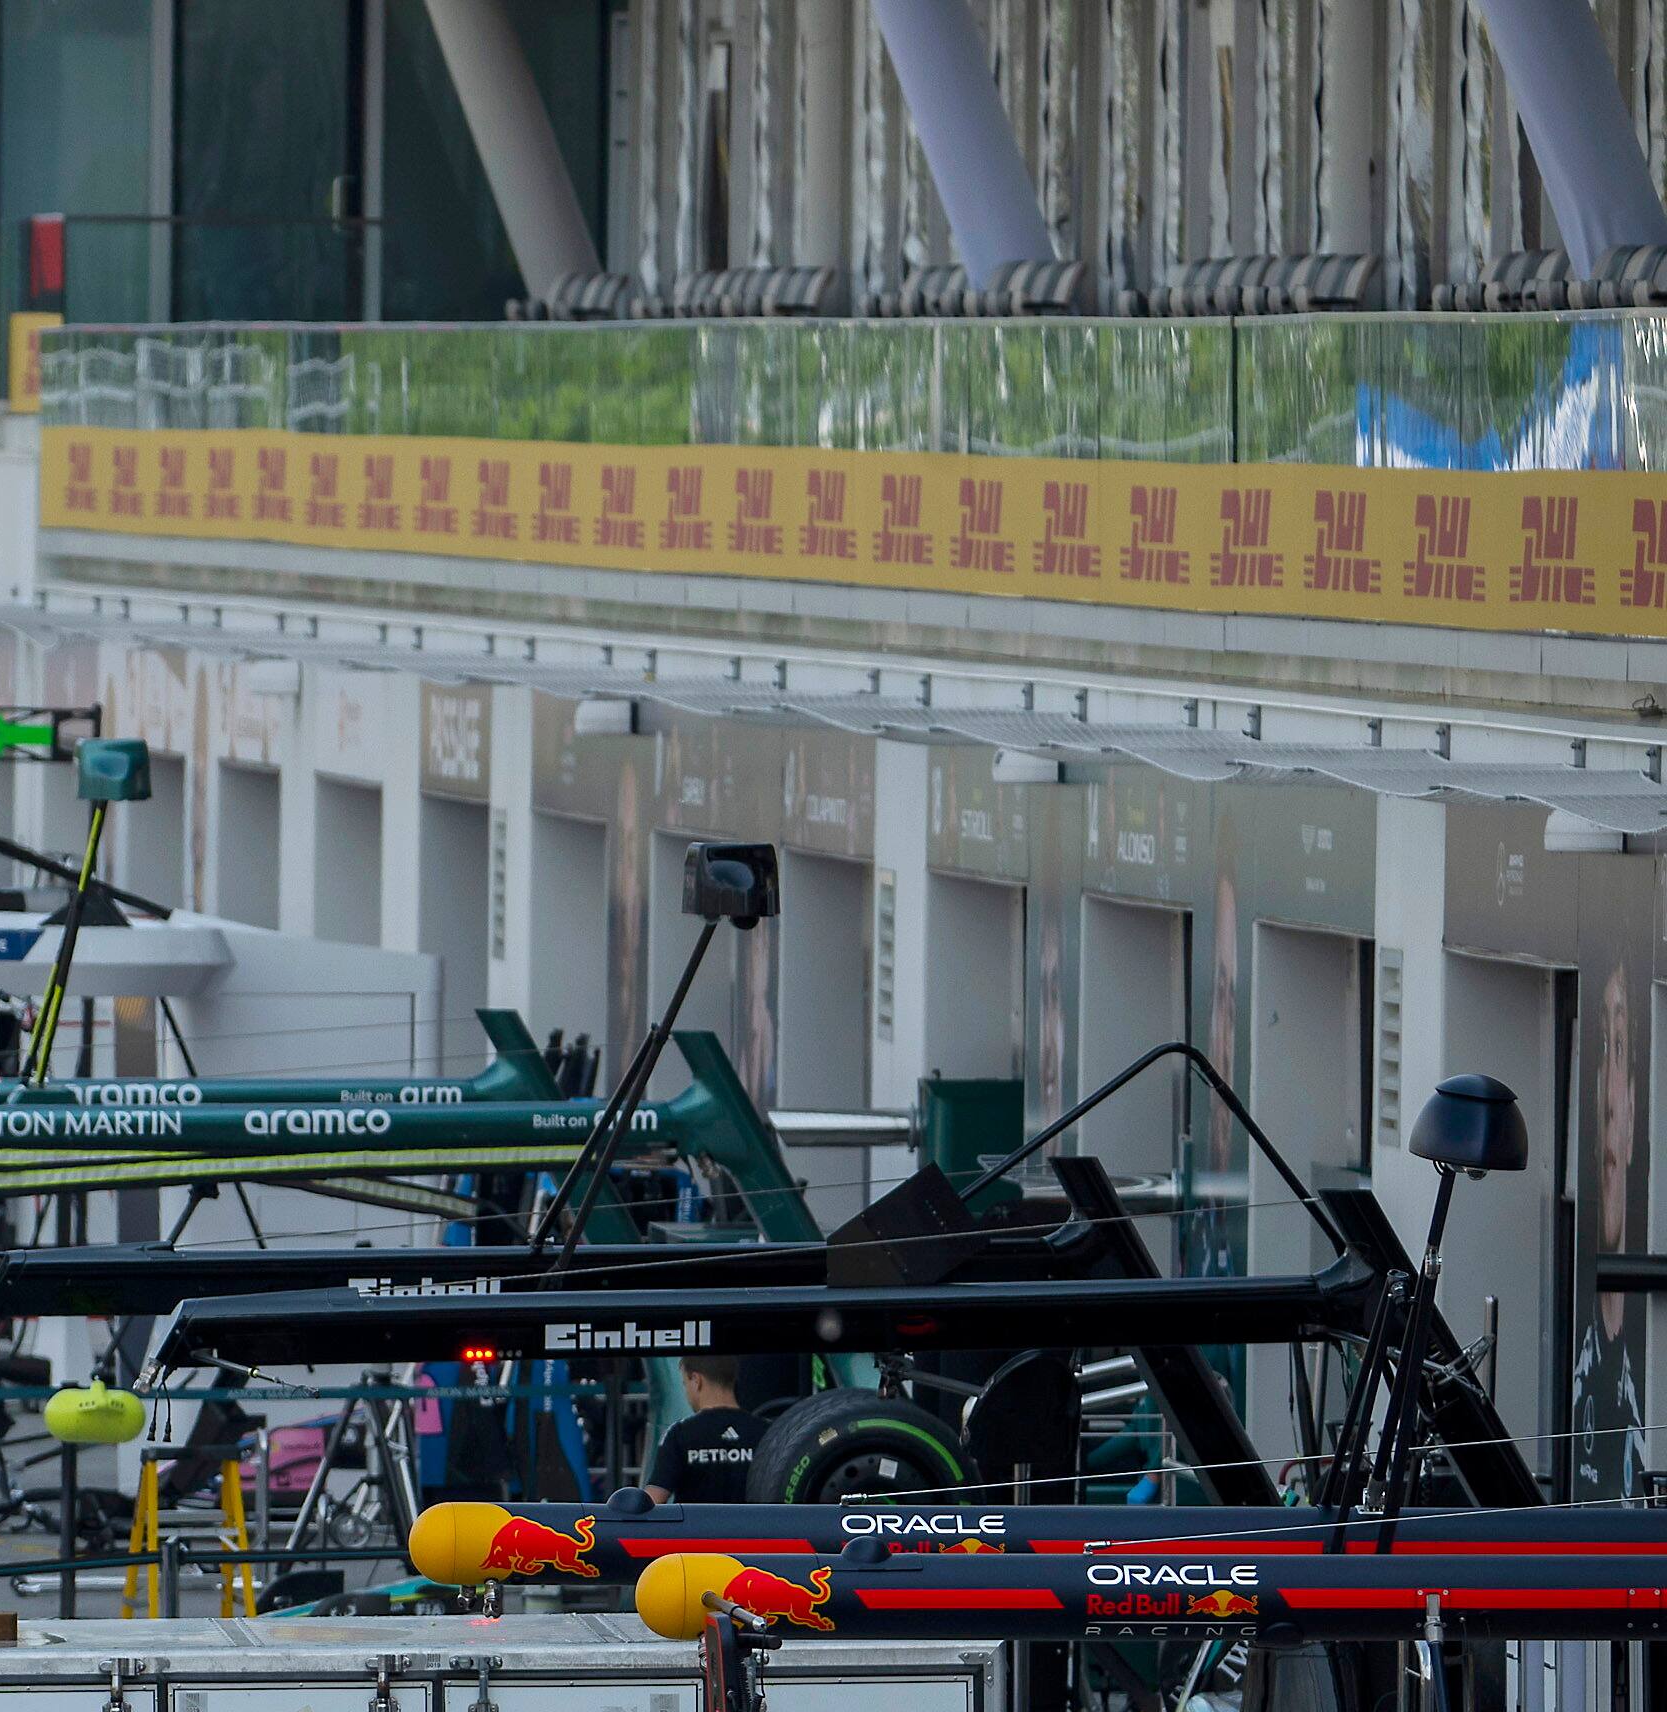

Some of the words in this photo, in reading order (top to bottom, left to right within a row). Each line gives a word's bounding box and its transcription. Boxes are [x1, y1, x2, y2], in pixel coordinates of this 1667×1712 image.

[65, 1110, 183, 1136] MARTIN
[244, 1108, 391, 1134] aramco
[532, 1113, 565, 1128] Built
[568, 1115, 588, 1128] on
[545, 1320, 711, 1350] Einhell
[841, 1513, 1005, 1535] ORACLE
[1086, 1564, 1259, 1585] ORACLE
[1087, 1592, 1132, 1615] Red
[1136, 1591, 1180, 1615] Bull
[1085, 1625, 1259, 1638] RACING
